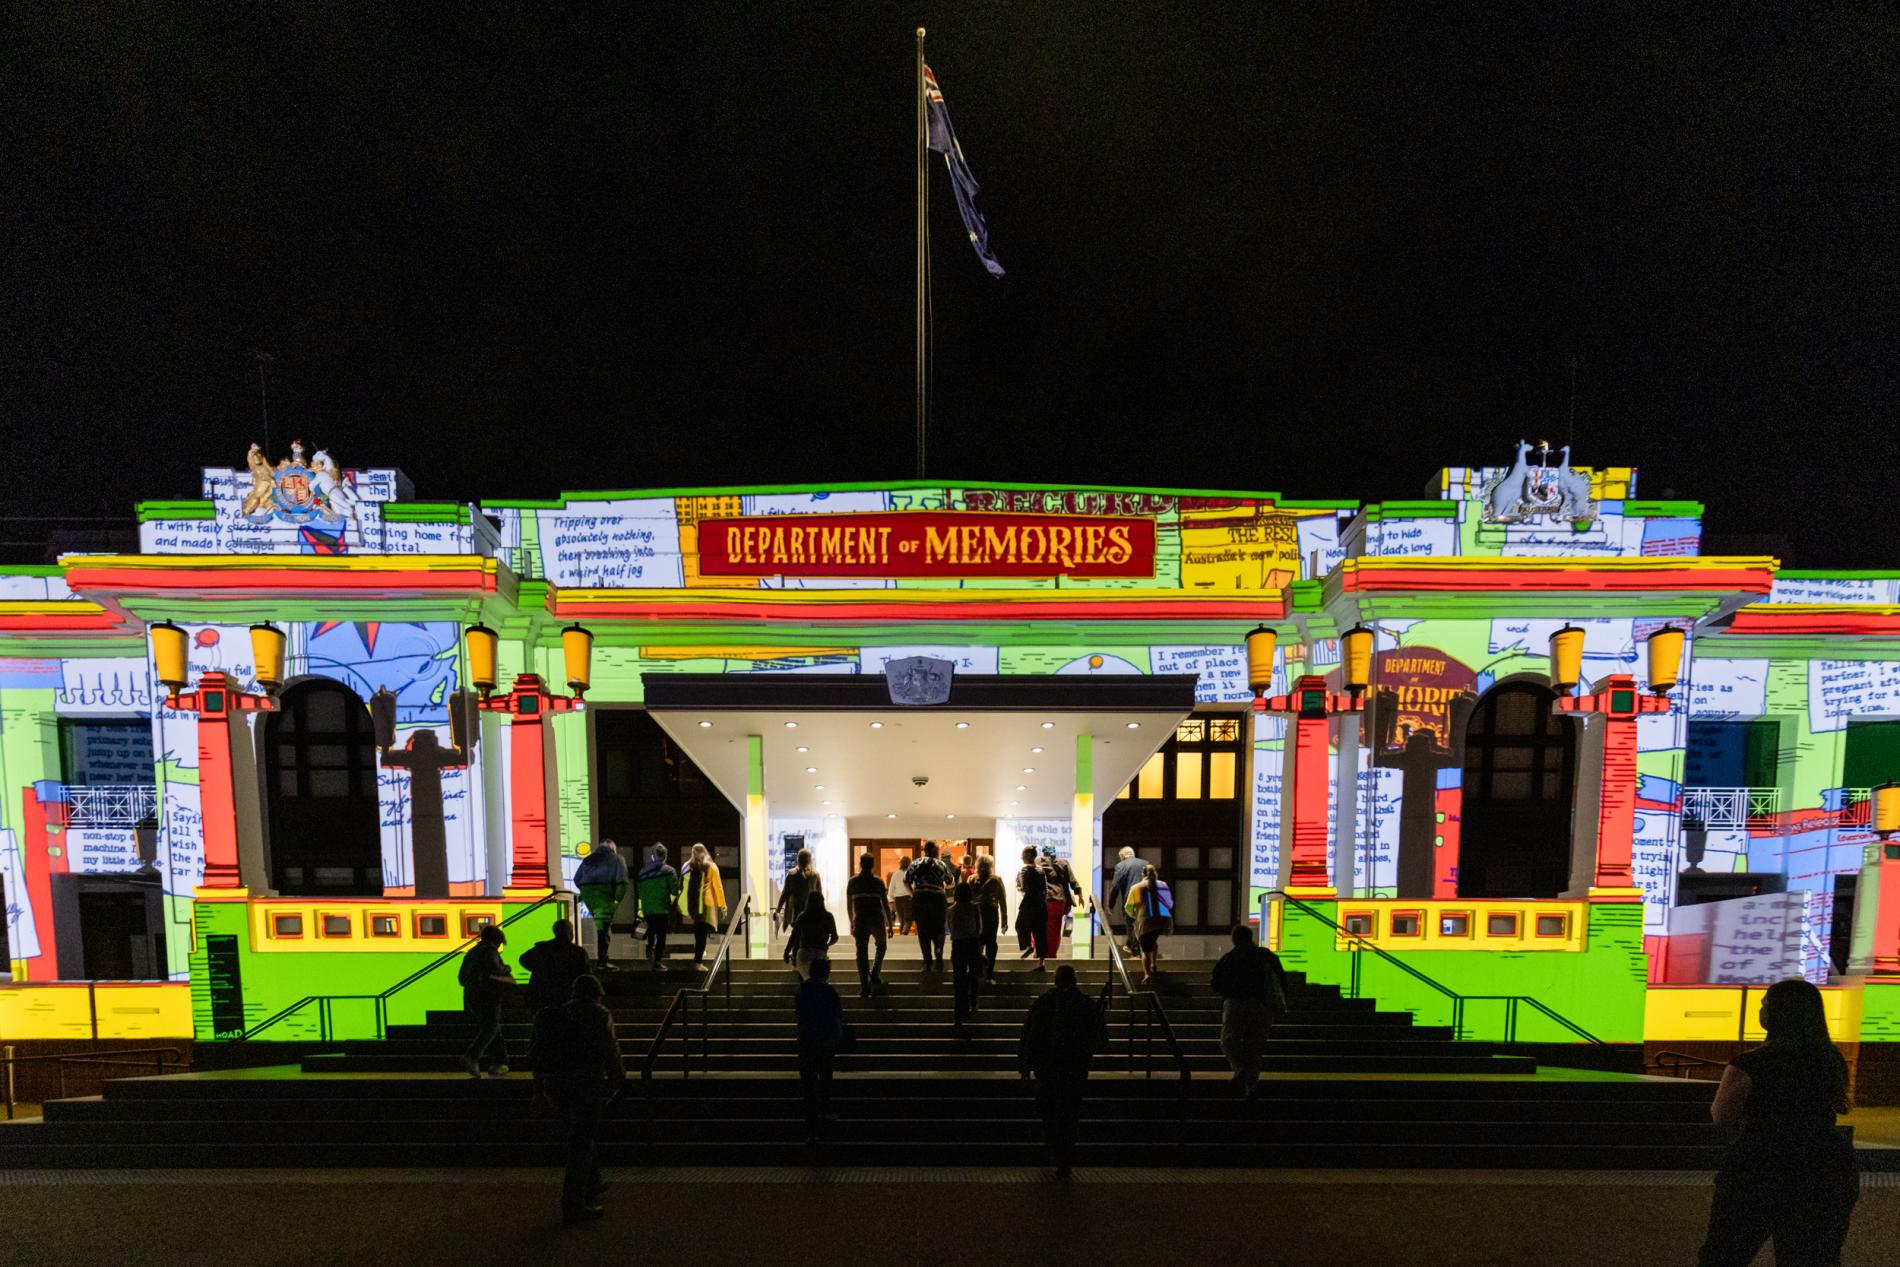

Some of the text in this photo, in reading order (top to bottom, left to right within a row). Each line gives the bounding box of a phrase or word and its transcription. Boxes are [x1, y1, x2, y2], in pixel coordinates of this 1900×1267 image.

[168, 522, 192, 531] with
[197, 522, 223, 533] fairy
[554, 516, 623, 529] Tripping over
[415, 529, 442, 540] home
[1228, 528, 1259, 543] THE
[1387, 531, 1398, 539] to
[1401, 528, 1422, 539] hide
[155, 536, 177, 546] and
[182, 538, 213, 548] made
[555, 532, 609, 547] absolutely
[727, 526, 1132, 568] DEPARTMENT OF MEMORIES
[1411, 543, 1432, 555] long
[603, 565, 624, 576] half
[628, 565, 643, 577] jog
[1158, 651, 1164, 660] I
[1171, 647, 1225, 658] remember
[1159, 658, 1238, 672] out of place
[1385, 658, 1446, 675] DEPARTMENT
[83, 832, 126, 841] non-stop
[172, 826, 191, 836] all
[83, 844, 128, 852] machine.
[172, 839, 197, 850] wish
[83, 856, 98, 865] my
[102, 856, 125, 864] little
[172, 854, 191, 863] the
[171, 867, 191, 876] car
[1639, 865, 1669, 876] light
[1730, 945, 1773, 955] the
[1720, 959, 1753, 969] of
